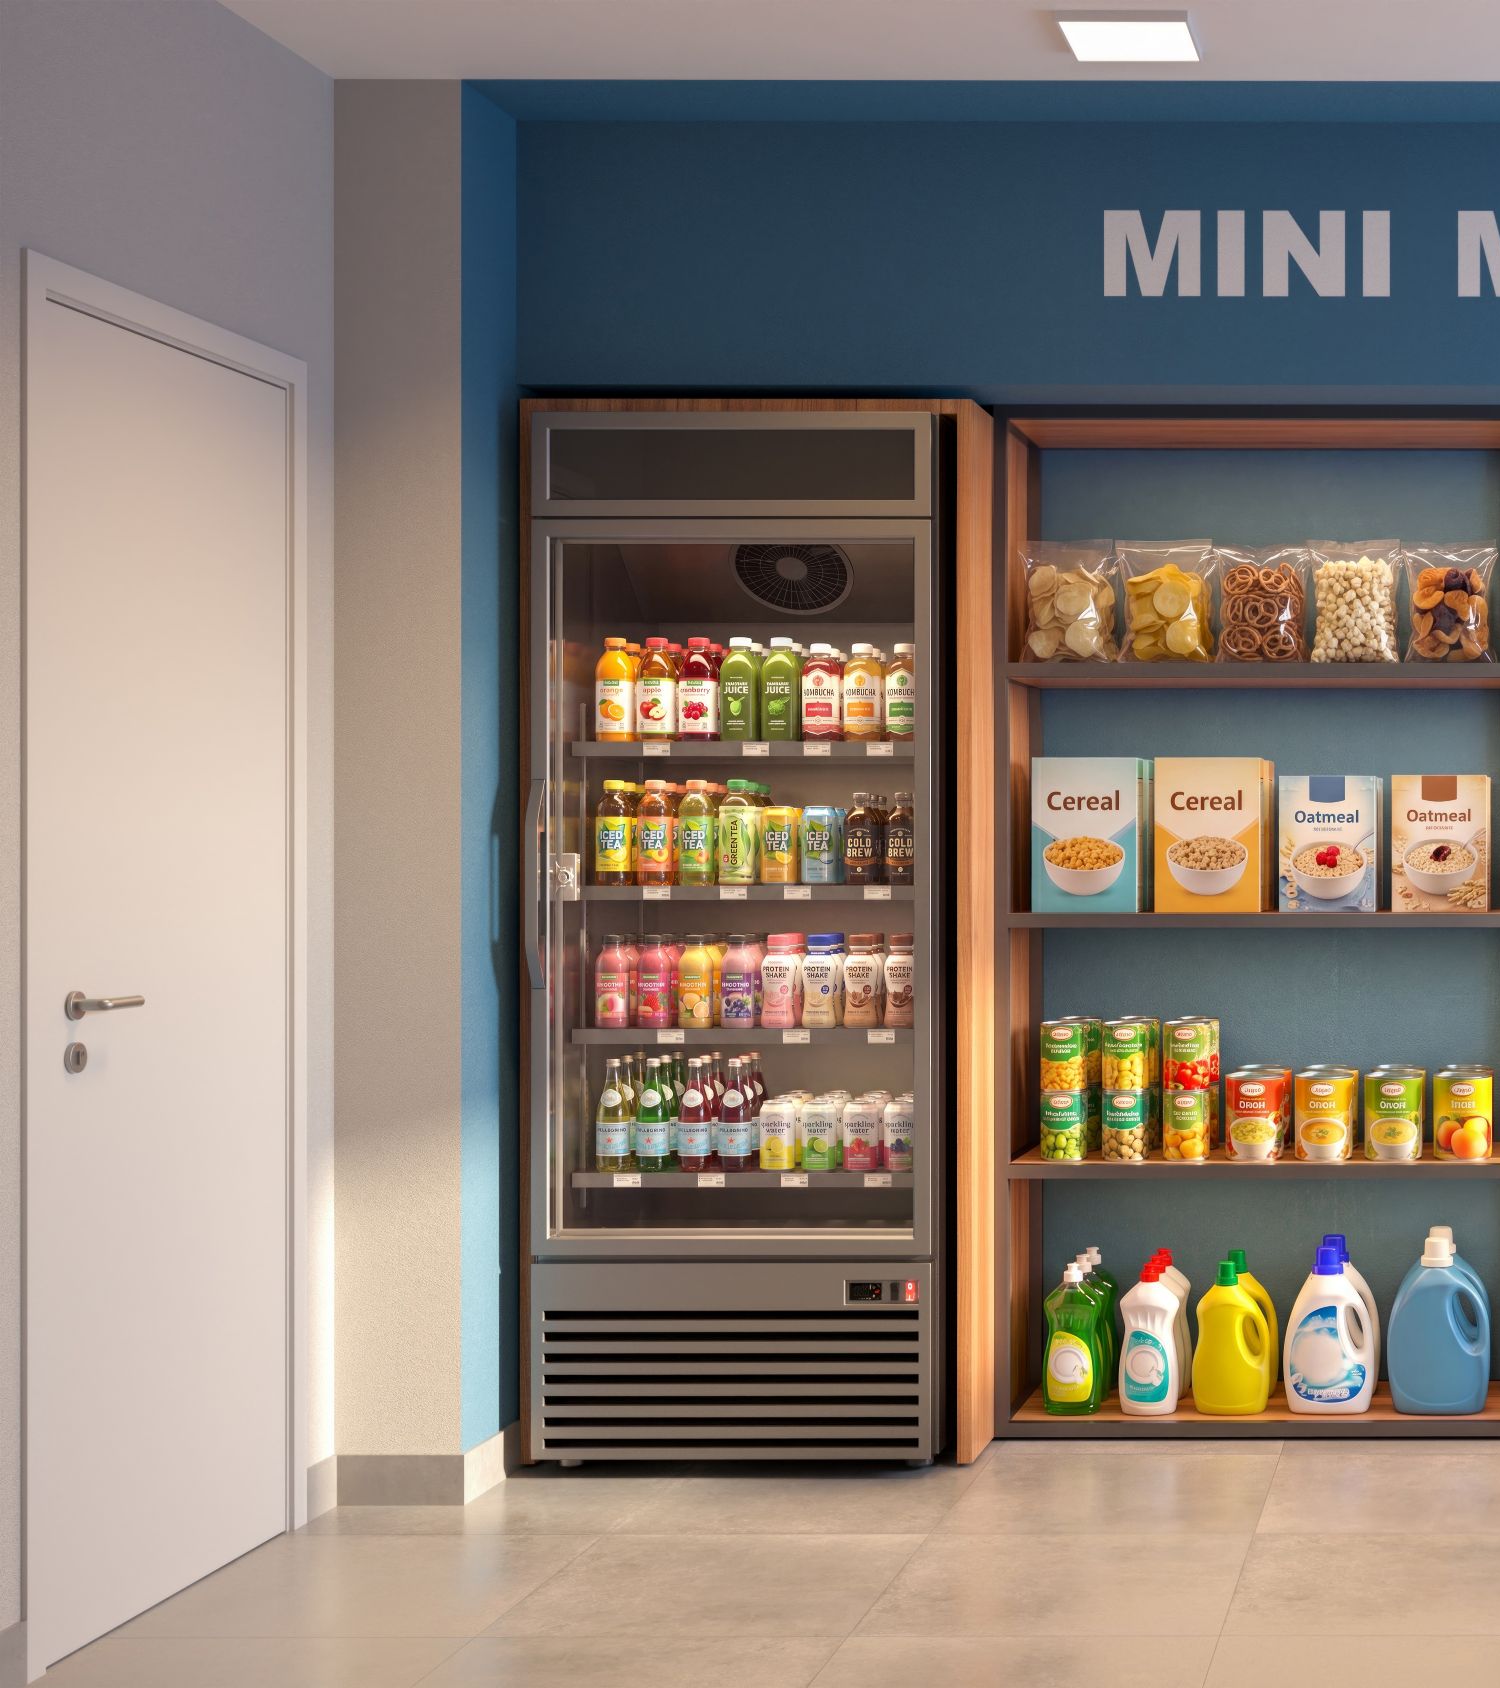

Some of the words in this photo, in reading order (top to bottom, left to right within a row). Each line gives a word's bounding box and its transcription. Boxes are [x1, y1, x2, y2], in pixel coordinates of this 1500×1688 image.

[1103, 209, 1391, 298] MINI
[723, 686, 749, 694] JUICE
[765, 686, 790, 694] JUICE
[887, 688, 915, 697] KOMBUCH
[1047, 789, 1120, 811] Cereal
[1170, 789, 1243, 811] Cereal
[1294, 809, 1360, 824] Oatmeal
[1406, 808, 1472, 823] Oatmeal
[730, 820, 738, 837] TEA
[600, 830, 623, 840] ICED
[641, 830, 664, 840] ICED
[682, 830, 705, 840] ICED
[765, 831, 789, 841] ICED
[806, 831, 830, 841] ICED
[601, 840, 622, 849] TEA
[642, 840, 663, 849] TEA
[683, 840, 704, 849] TEA
[766, 841, 788, 851] TEA
[807, 841, 829, 851] TEA
[847, 838, 872, 848] COLD
[888, 838, 913, 848] COLD
[846, 848, 873, 857] BREW
[887, 848, 914, 857] BREW
